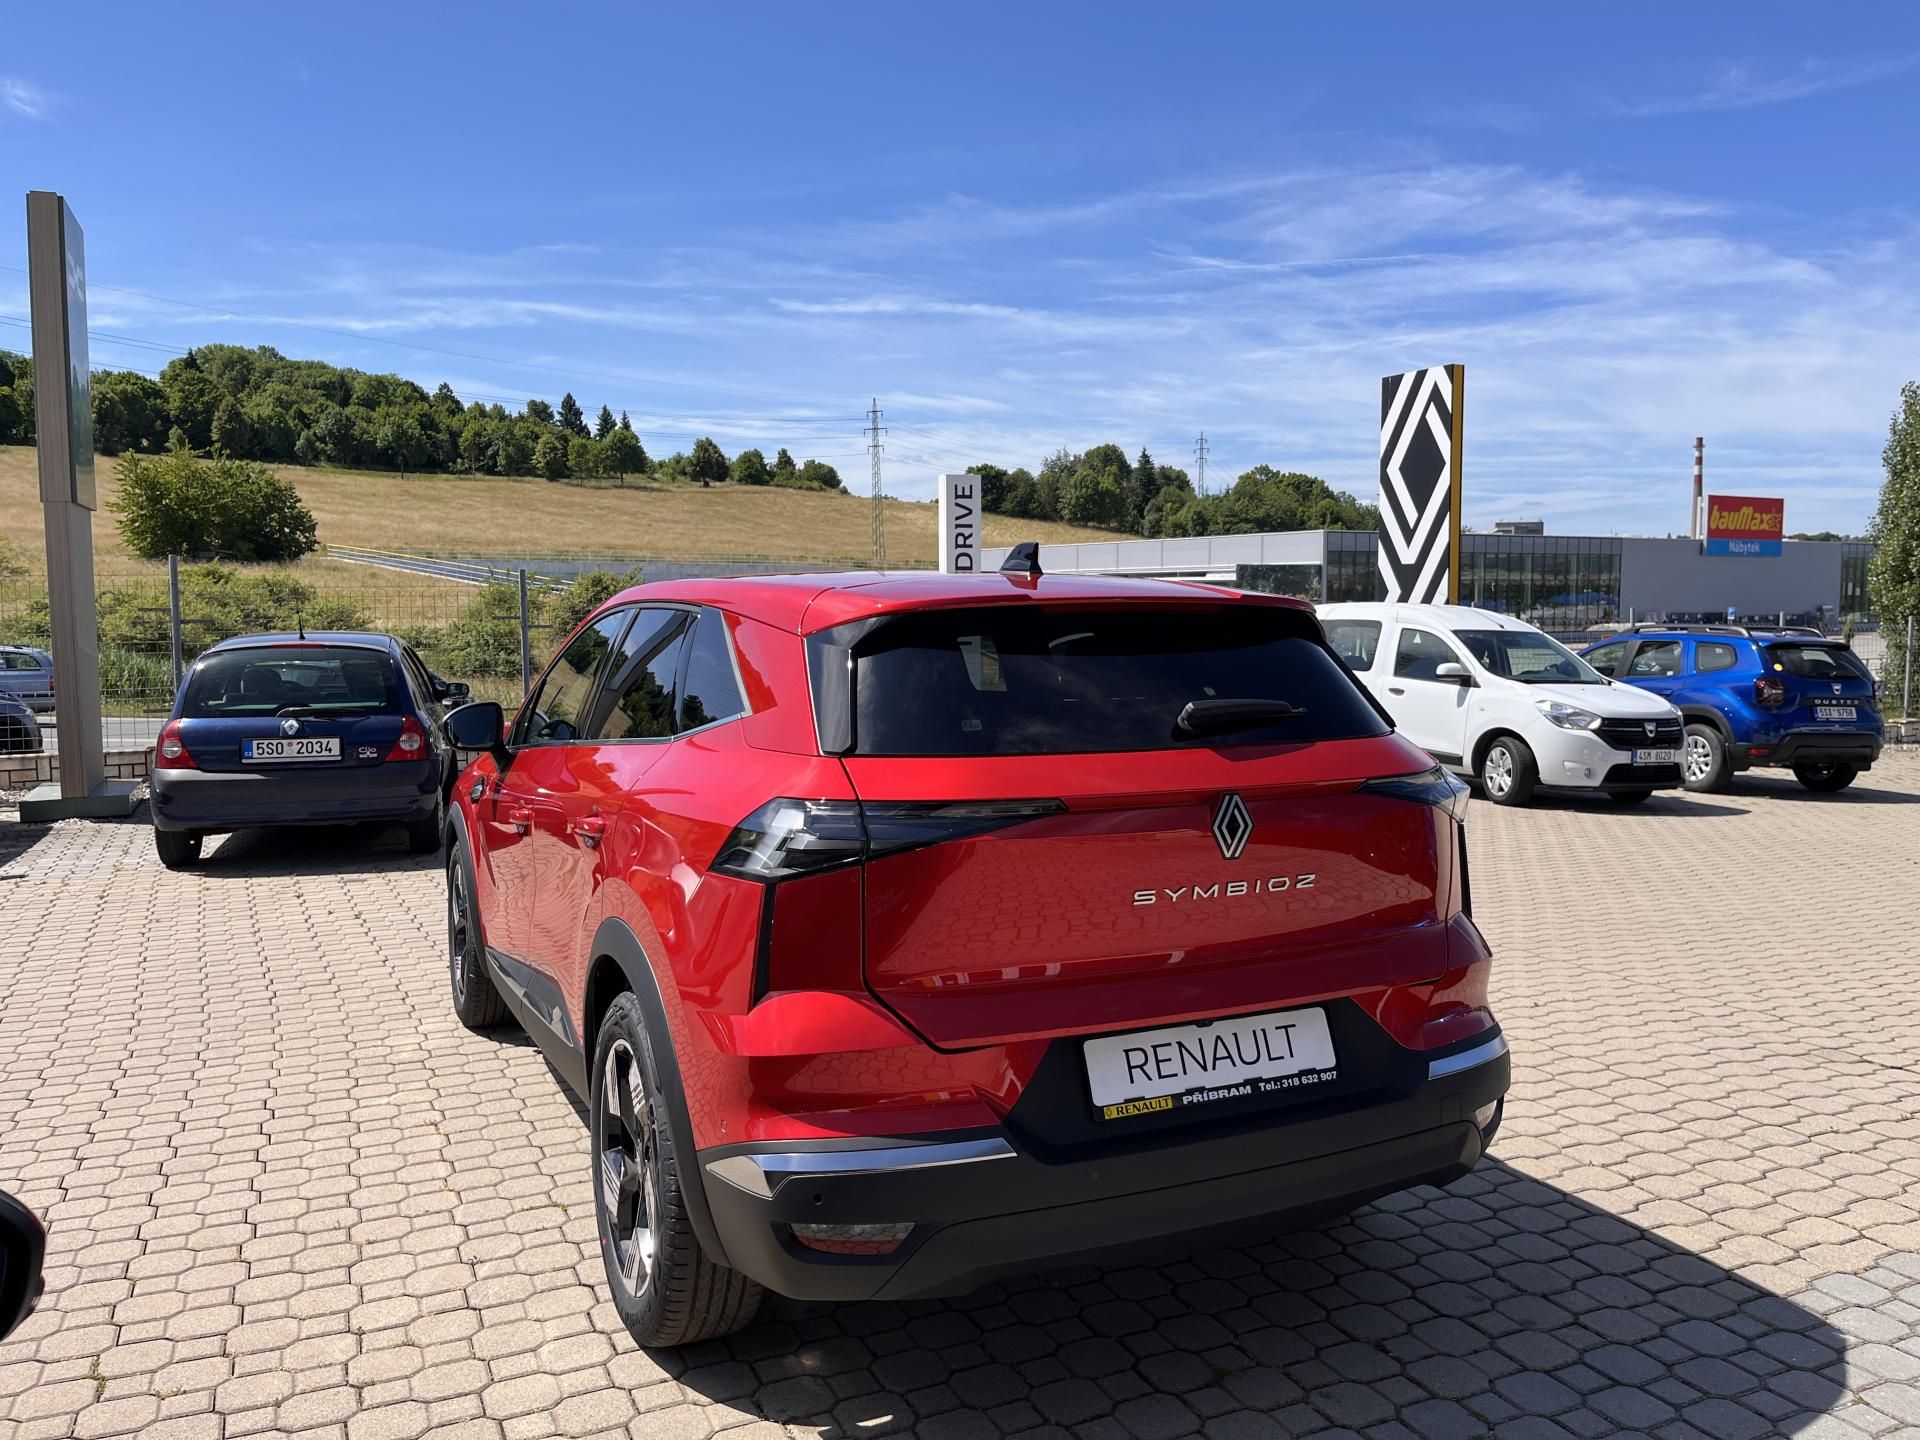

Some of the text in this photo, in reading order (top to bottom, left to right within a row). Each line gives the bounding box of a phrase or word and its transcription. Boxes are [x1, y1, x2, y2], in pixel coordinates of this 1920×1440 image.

[954, 484, 973, 571] DRIVE
[1728, 540, 1761, 555] Nábytek
[296, 740, 333, 755] 2034
[1133, 873, 1316, 906] SYMBIOZ
[1122, 1023, 1297, 1085] RENAULT
[1182, 1071, 1338, 1105] PŘÍBRAM Tel.: 318 632 907
[1115, 1098, 1171, 1117] RENAULT
